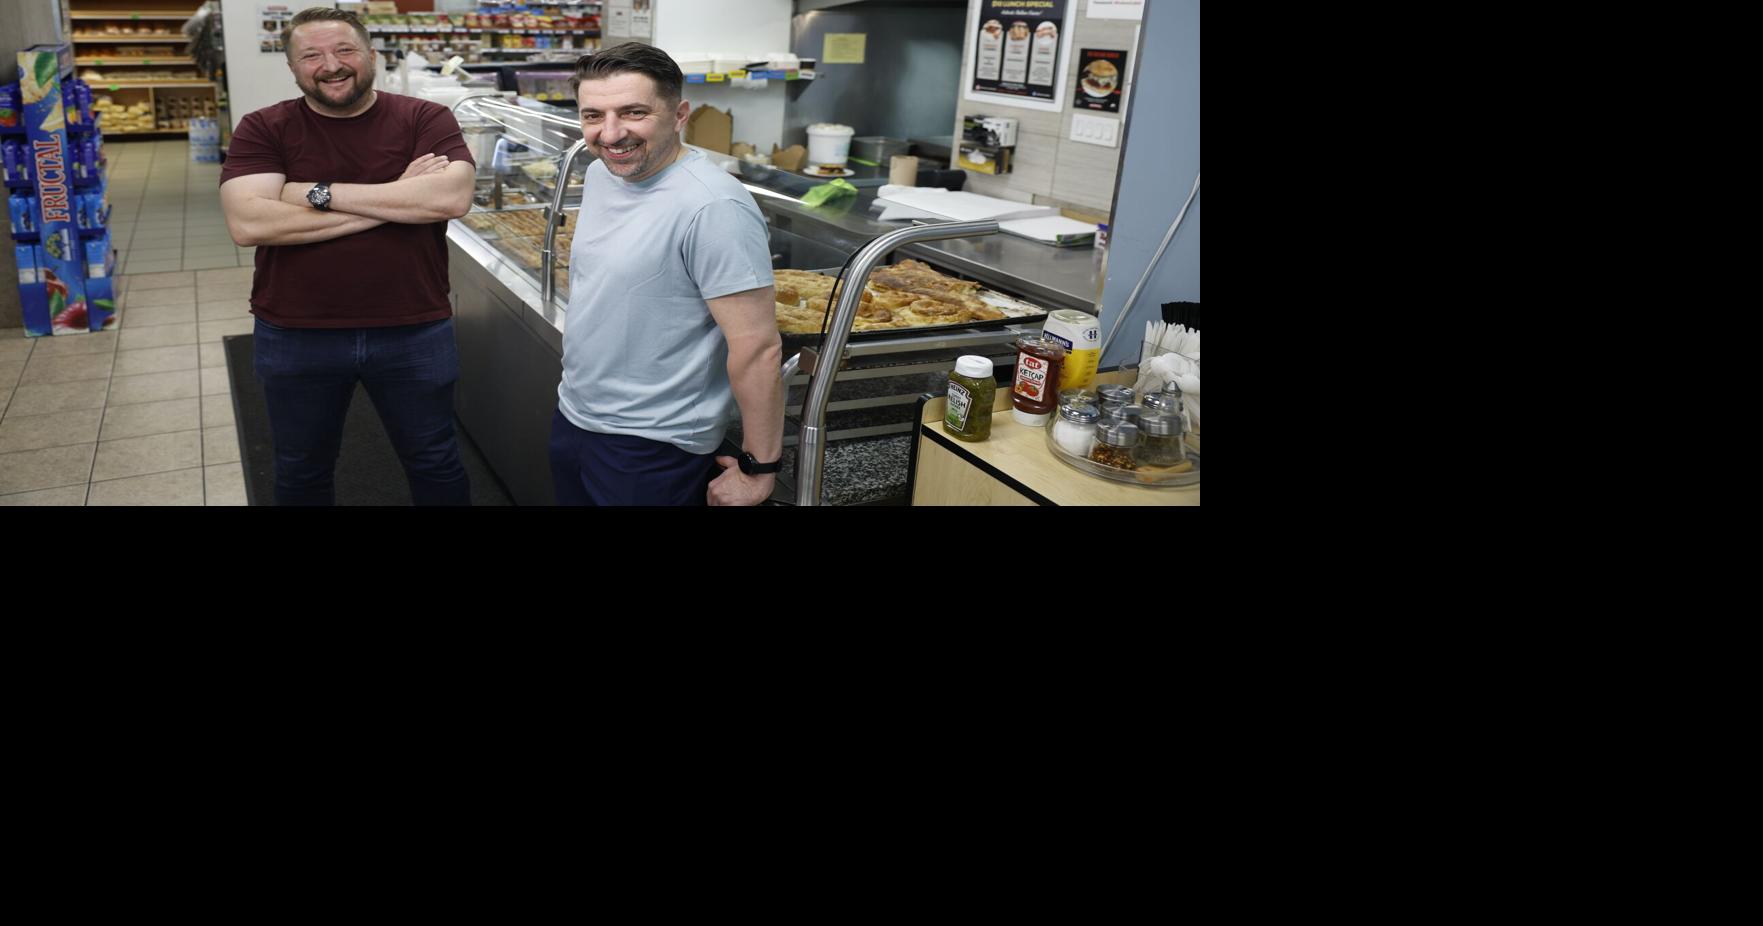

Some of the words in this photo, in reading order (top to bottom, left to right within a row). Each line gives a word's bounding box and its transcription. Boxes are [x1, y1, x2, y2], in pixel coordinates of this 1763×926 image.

[1003, 0, 1025, 8] LUNCH
[33, 133, 71, 223] FRUCTAL
[1024, 358, 1039, 369] tat
[1020, 367, 1044, 381] KETÇAP
[950, 384, 966, 396] HEINZ
[948, 394, 967, 409] RELISH
